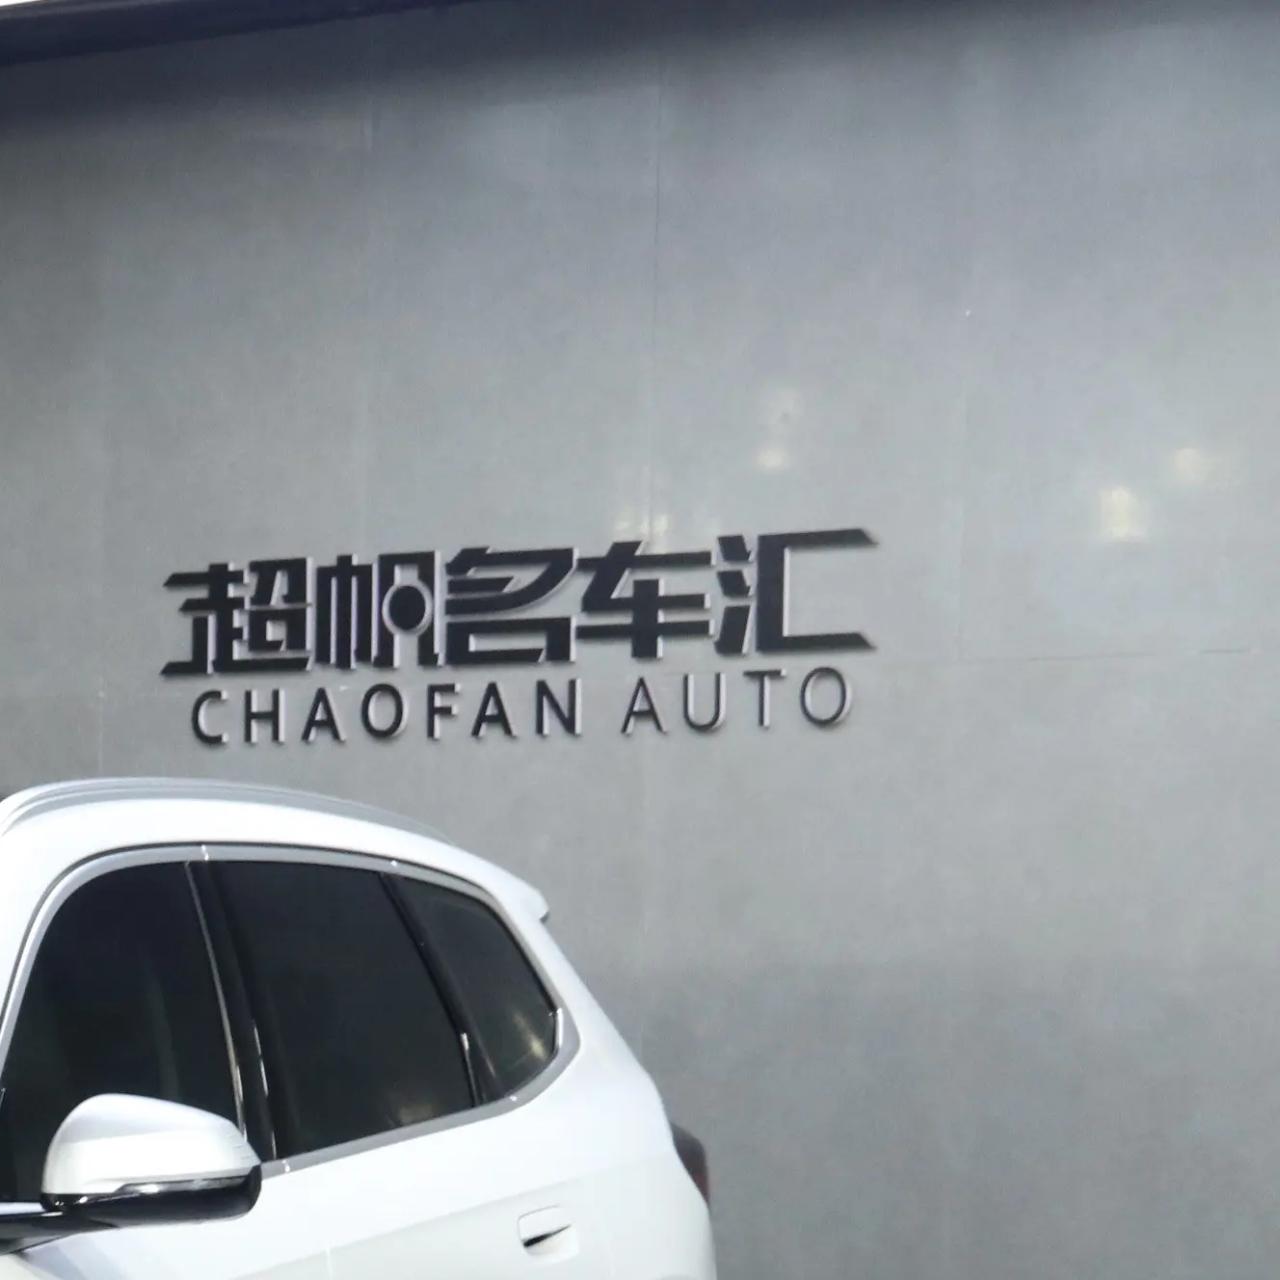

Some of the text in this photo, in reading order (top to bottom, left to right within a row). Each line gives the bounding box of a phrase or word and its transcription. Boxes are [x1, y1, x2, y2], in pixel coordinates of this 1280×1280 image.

[161, 528, 878, 675] 超帆名车汇
[191, 666, 853, 746] CHAOFAN AUTO
